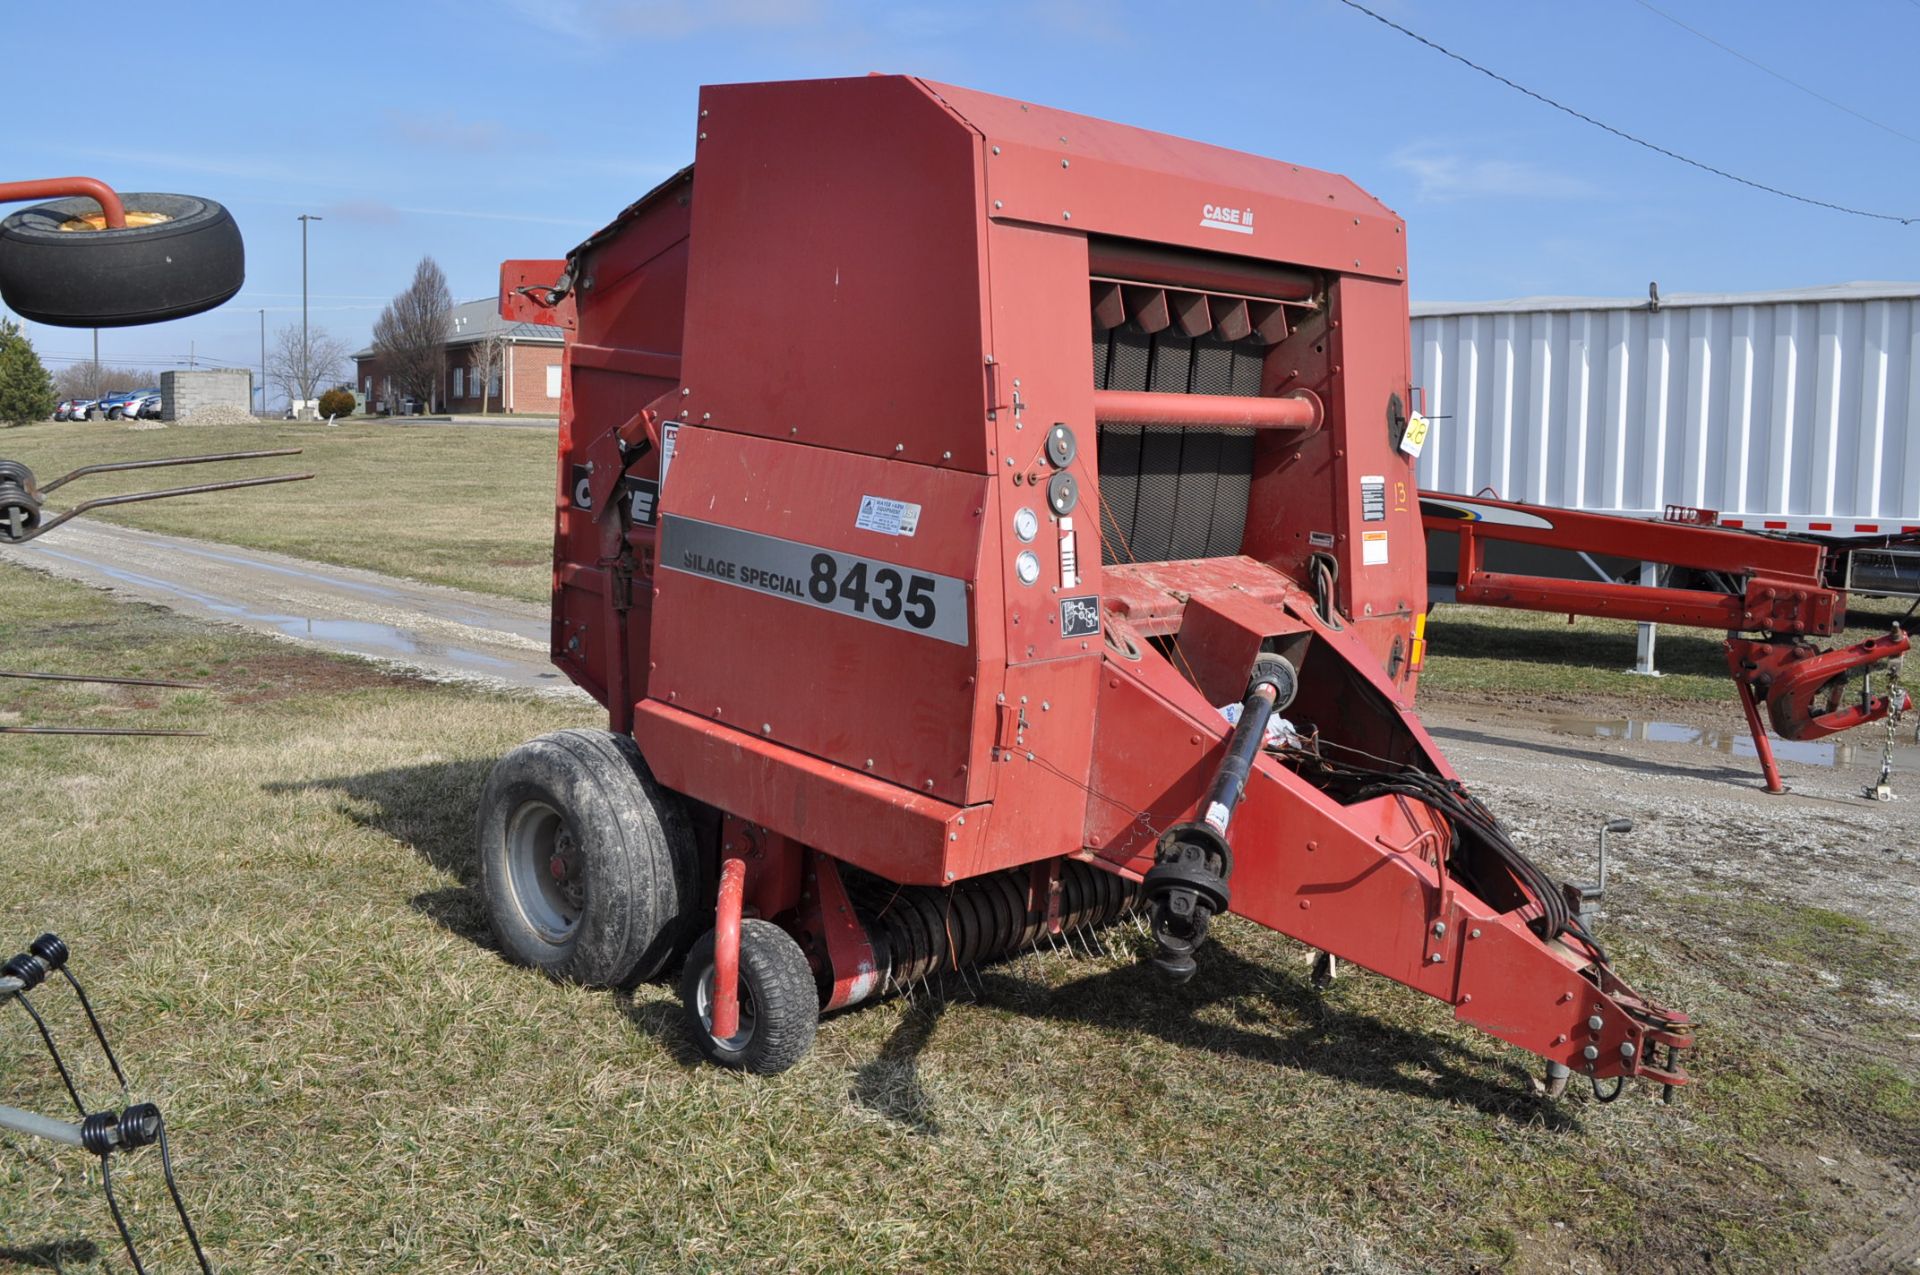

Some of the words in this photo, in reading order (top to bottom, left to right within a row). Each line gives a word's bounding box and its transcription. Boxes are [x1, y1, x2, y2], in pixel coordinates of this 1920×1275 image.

[1203, 203, 1240, 223] CASE
[683, 551, 736, 580] SILAGE
[739, 566, 805, 598] SPECIAL
[808, 552, 936, 630] 8435
